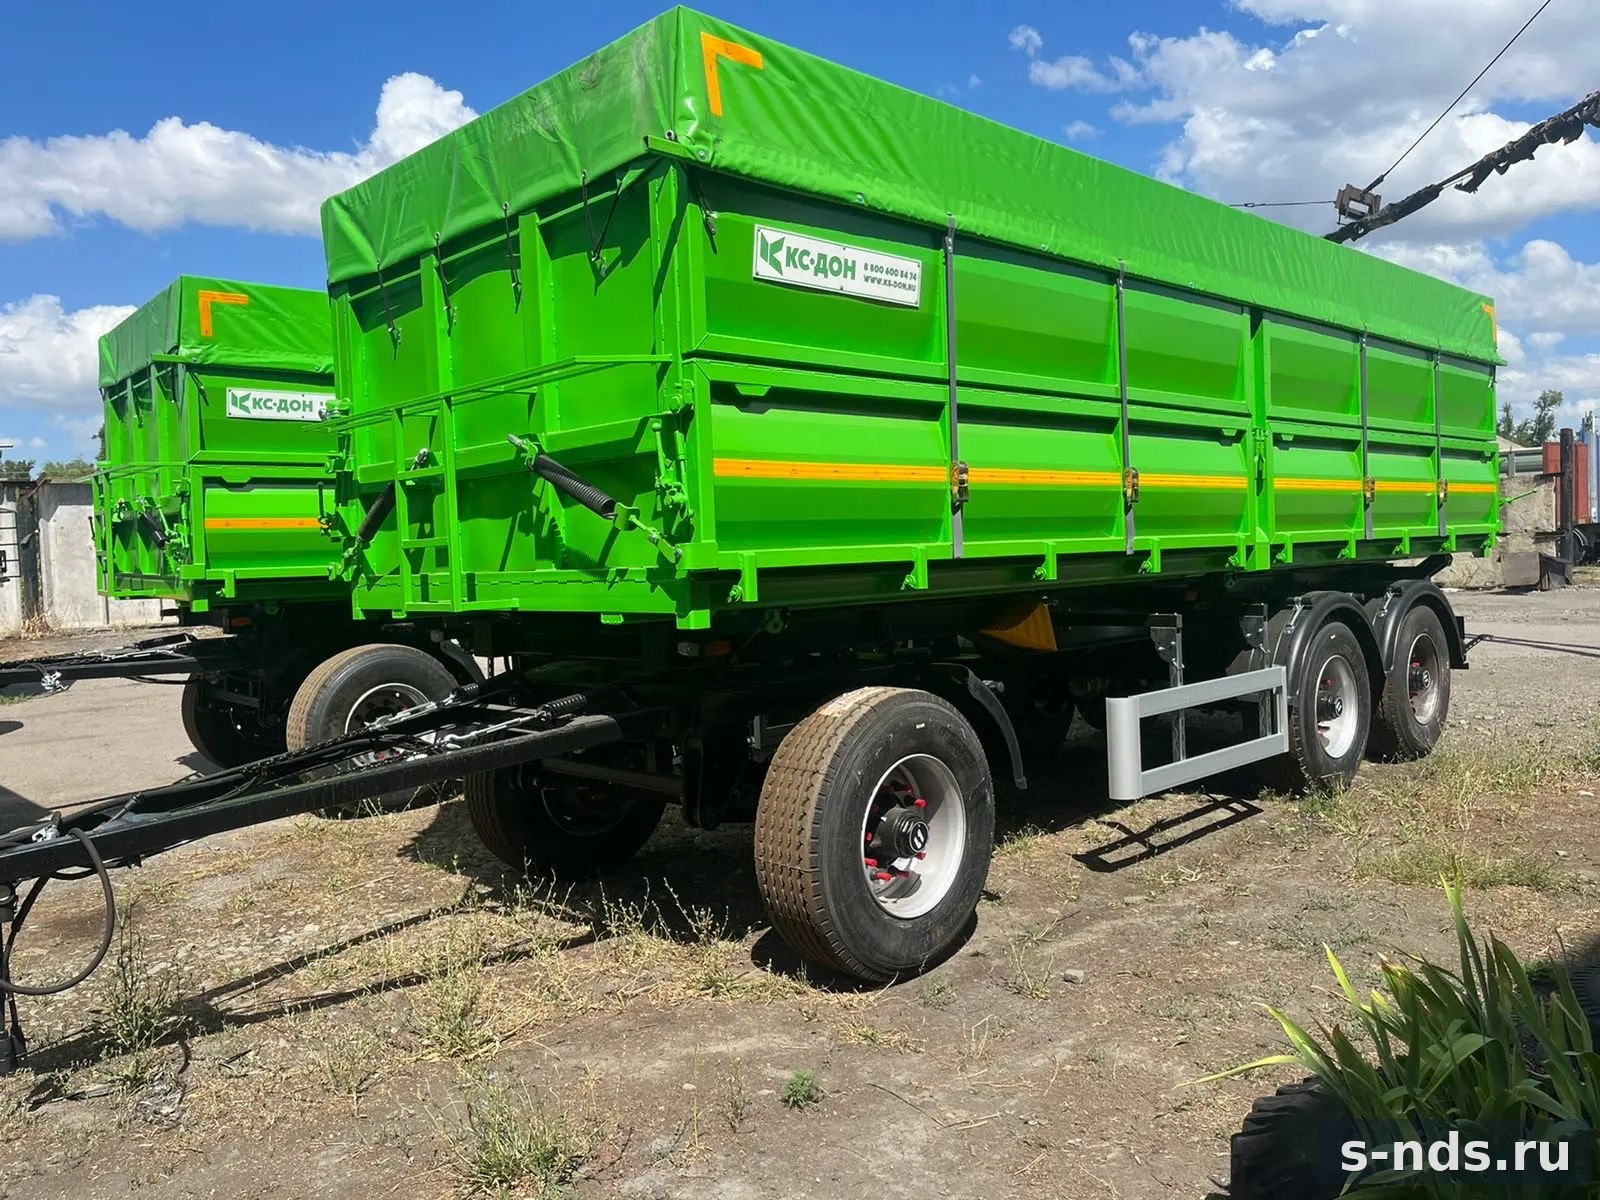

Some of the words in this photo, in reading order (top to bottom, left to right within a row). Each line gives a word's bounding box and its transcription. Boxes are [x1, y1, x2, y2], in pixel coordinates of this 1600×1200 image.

[863, 262, 869, 271] 8
[870, 263, 884, 274] 800
[885, 267, 899, 277] 600
